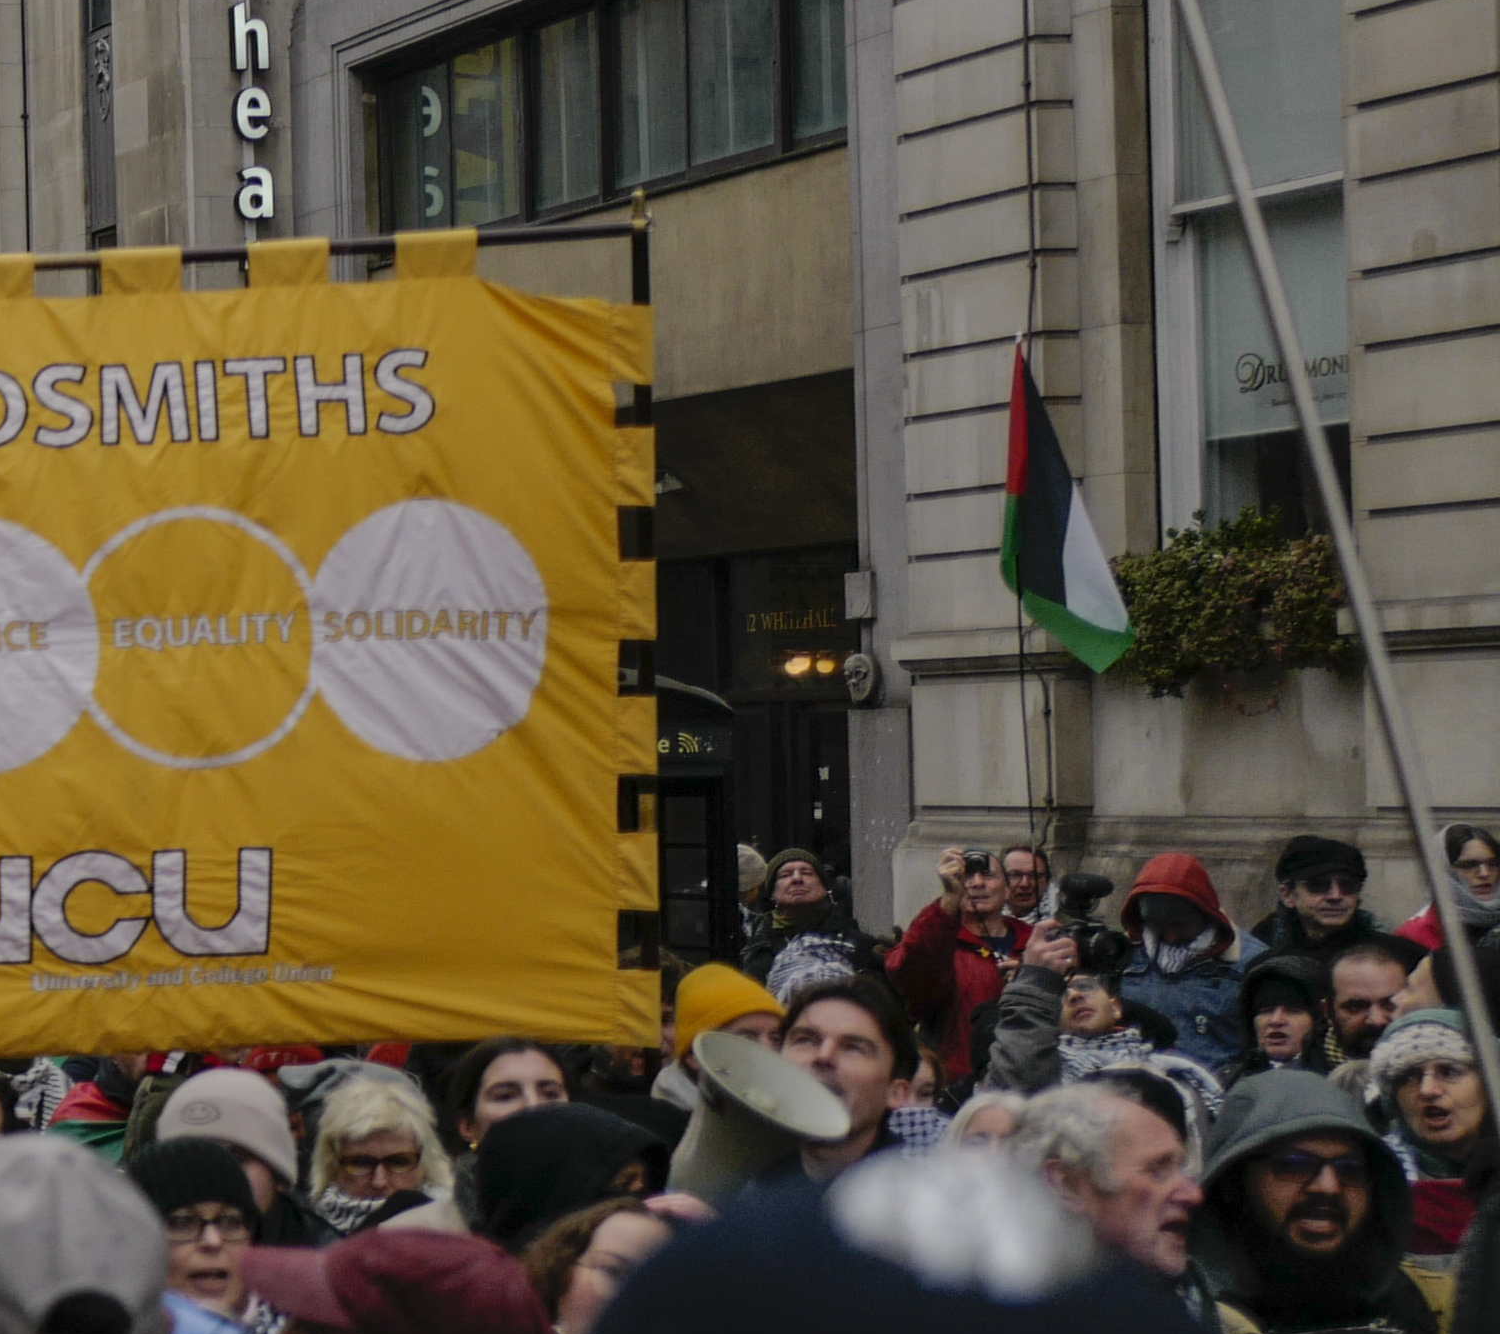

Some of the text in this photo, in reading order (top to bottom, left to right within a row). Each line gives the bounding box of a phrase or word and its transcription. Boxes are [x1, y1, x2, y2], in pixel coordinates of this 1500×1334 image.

[111, 611, 296, 651] EQUALITY
[322, 607, 540, 644] SOLIDARITY
[31, 962, 334, 992] University and College Union
